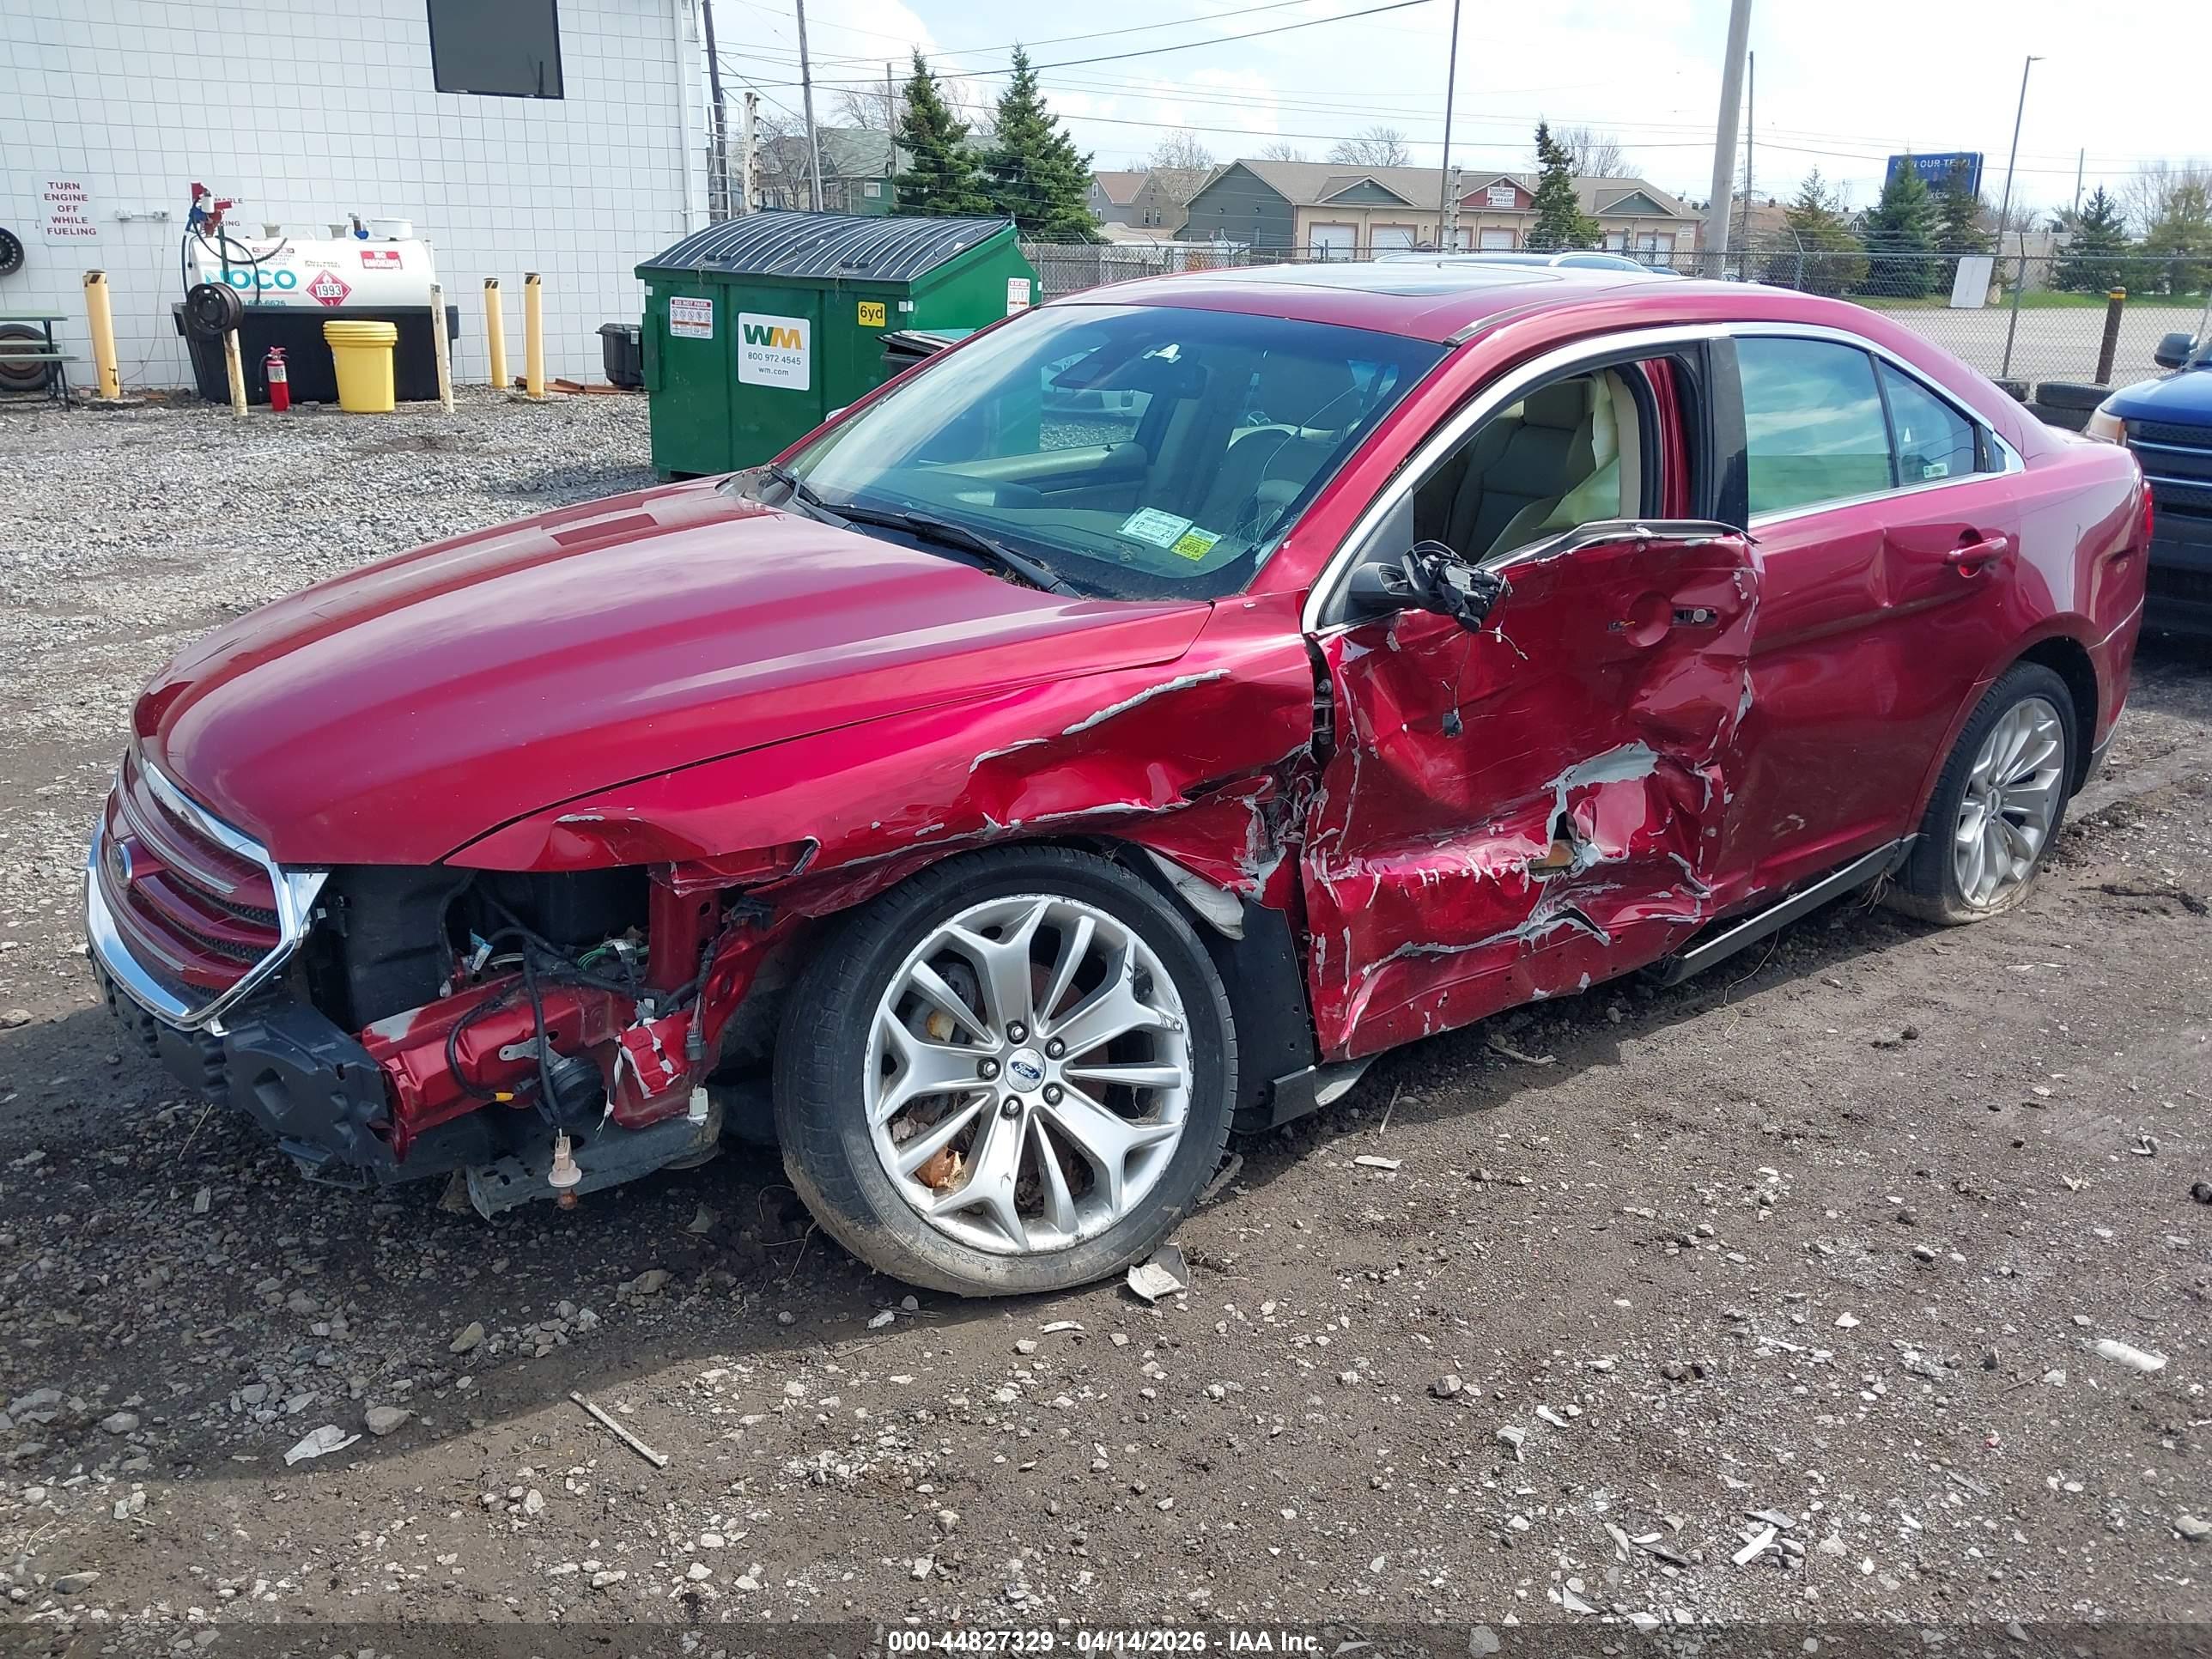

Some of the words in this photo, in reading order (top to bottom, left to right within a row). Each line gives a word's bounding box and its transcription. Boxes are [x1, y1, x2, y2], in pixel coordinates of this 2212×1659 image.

[47, 181, 81, 190] TURN
[46, 227, 97, 235] FUELING
[317, 285, 342, 296] 1993
[860, 306, 883, 322] 6yd
[743, 324, 802, 350] WM
[748, 351, 763, 361] 800
[765, 354, 779, 362] 972
[781, 356, 801, 366] 4545
[758, 367, 789, 376] wm.com
[1133, 520, 1146, 530] 12
[1160, 529, 1175, 539] 23
[1014, 1062, 1036, 1079] Ford
